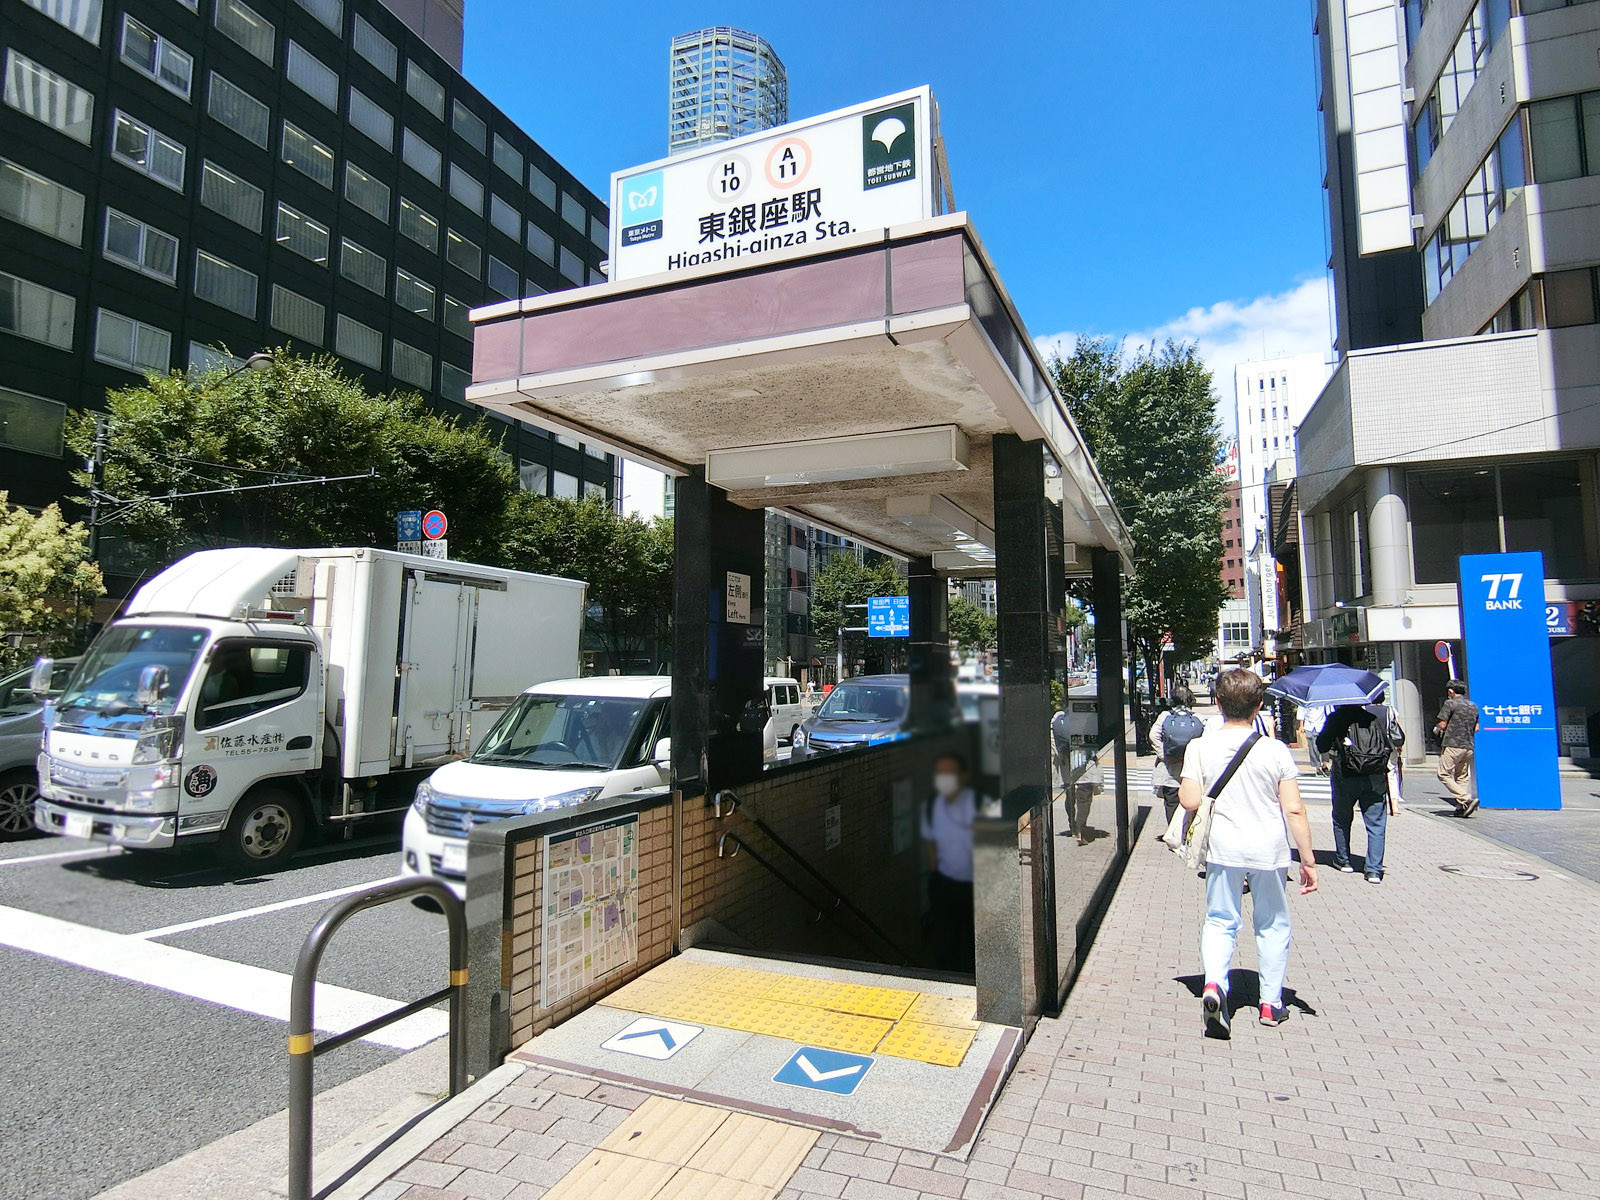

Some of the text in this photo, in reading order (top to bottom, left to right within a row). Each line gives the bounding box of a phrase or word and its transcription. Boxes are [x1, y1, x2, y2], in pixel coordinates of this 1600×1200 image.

[781, 147, 794, 161] A
[724, 162, 735, 176] H
[779, 162, 797, 179] 11
[867, 169, 912, 185] TOEI SUBWAY
[721, 177, 740, 193] 10
[698, 188, 822, 244] 東銀座駅
[628, 225, 656, 237] 東京メトロ
[815, 220, 856, 241] Sta.
[1481, 573, 1523, 599] 77
[1485, 600, 1523, 610] BANK
[727, 609, 739, 619] Left
[1482, 705, 1542, 715] 七十七銀行
[1495, 716, 1531, 724] 東京支店
